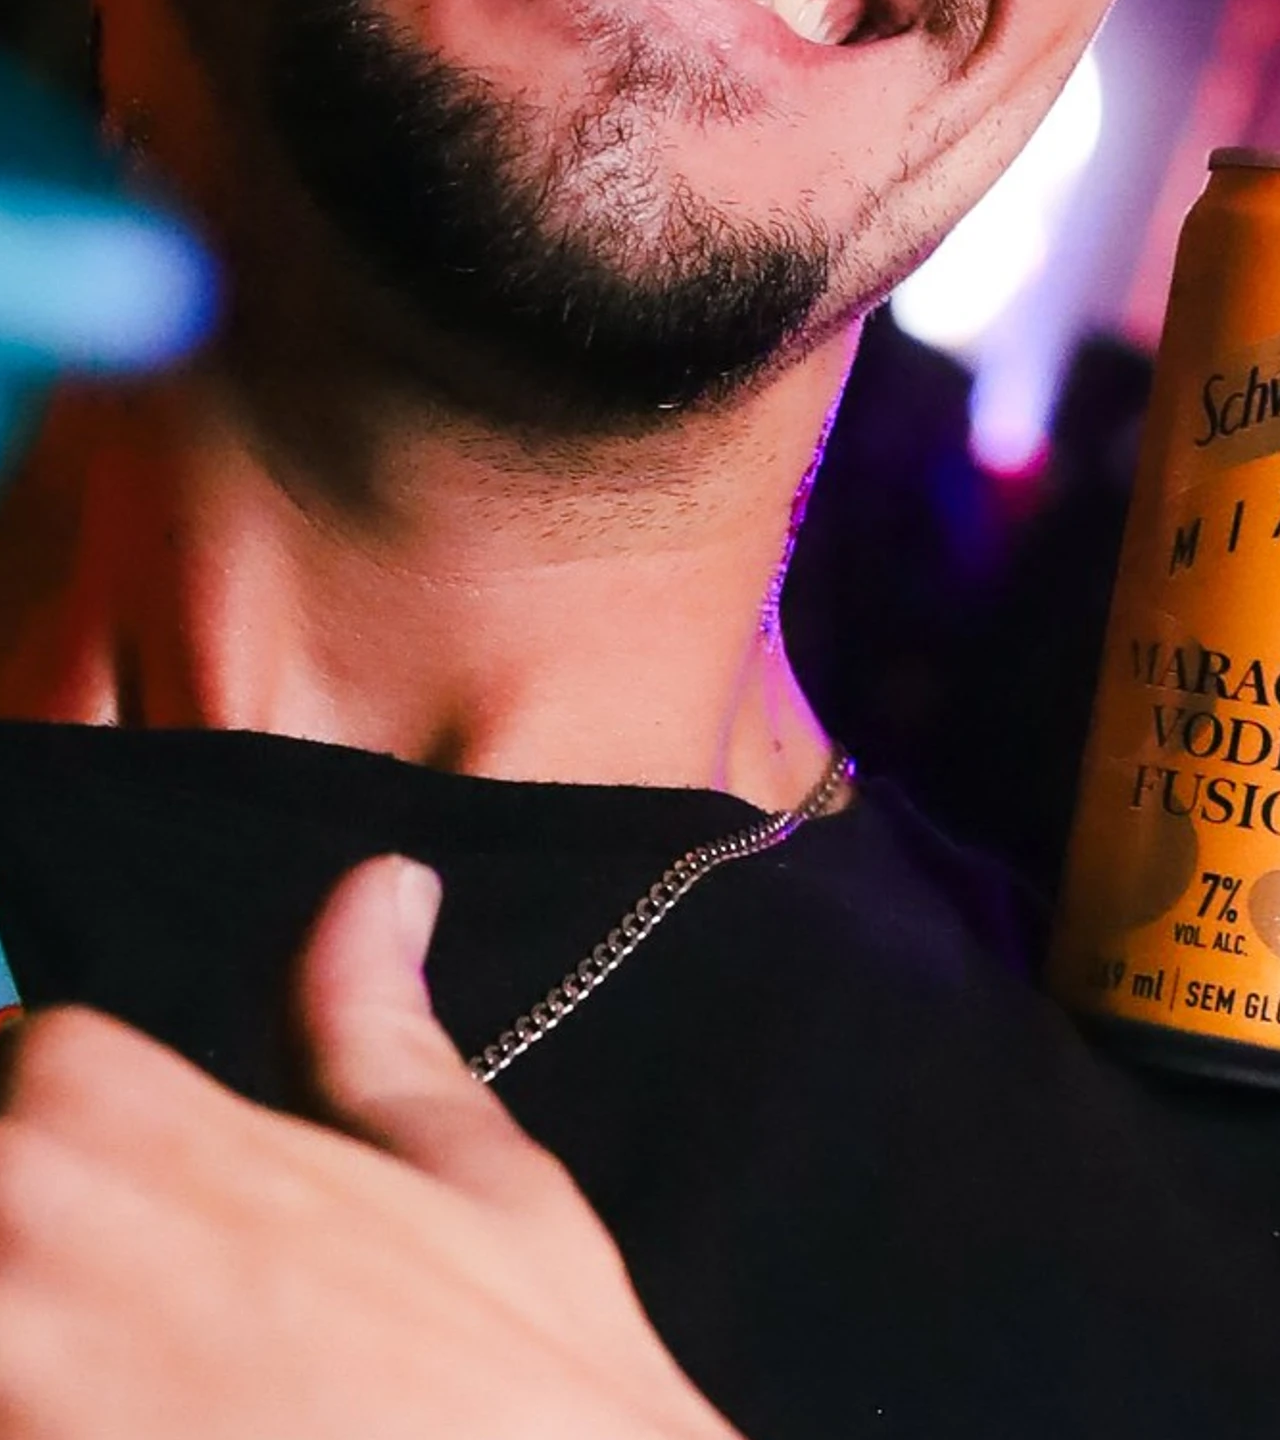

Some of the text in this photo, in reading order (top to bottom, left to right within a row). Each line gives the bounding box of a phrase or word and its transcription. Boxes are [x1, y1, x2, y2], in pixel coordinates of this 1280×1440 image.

[1196, 872, 1243, 924] 7%
[1212, 931, 1249, 957] ALC.
[1131, 969, 1165, 1001] ml
[1184, 980, 1237, 1015] SEM
